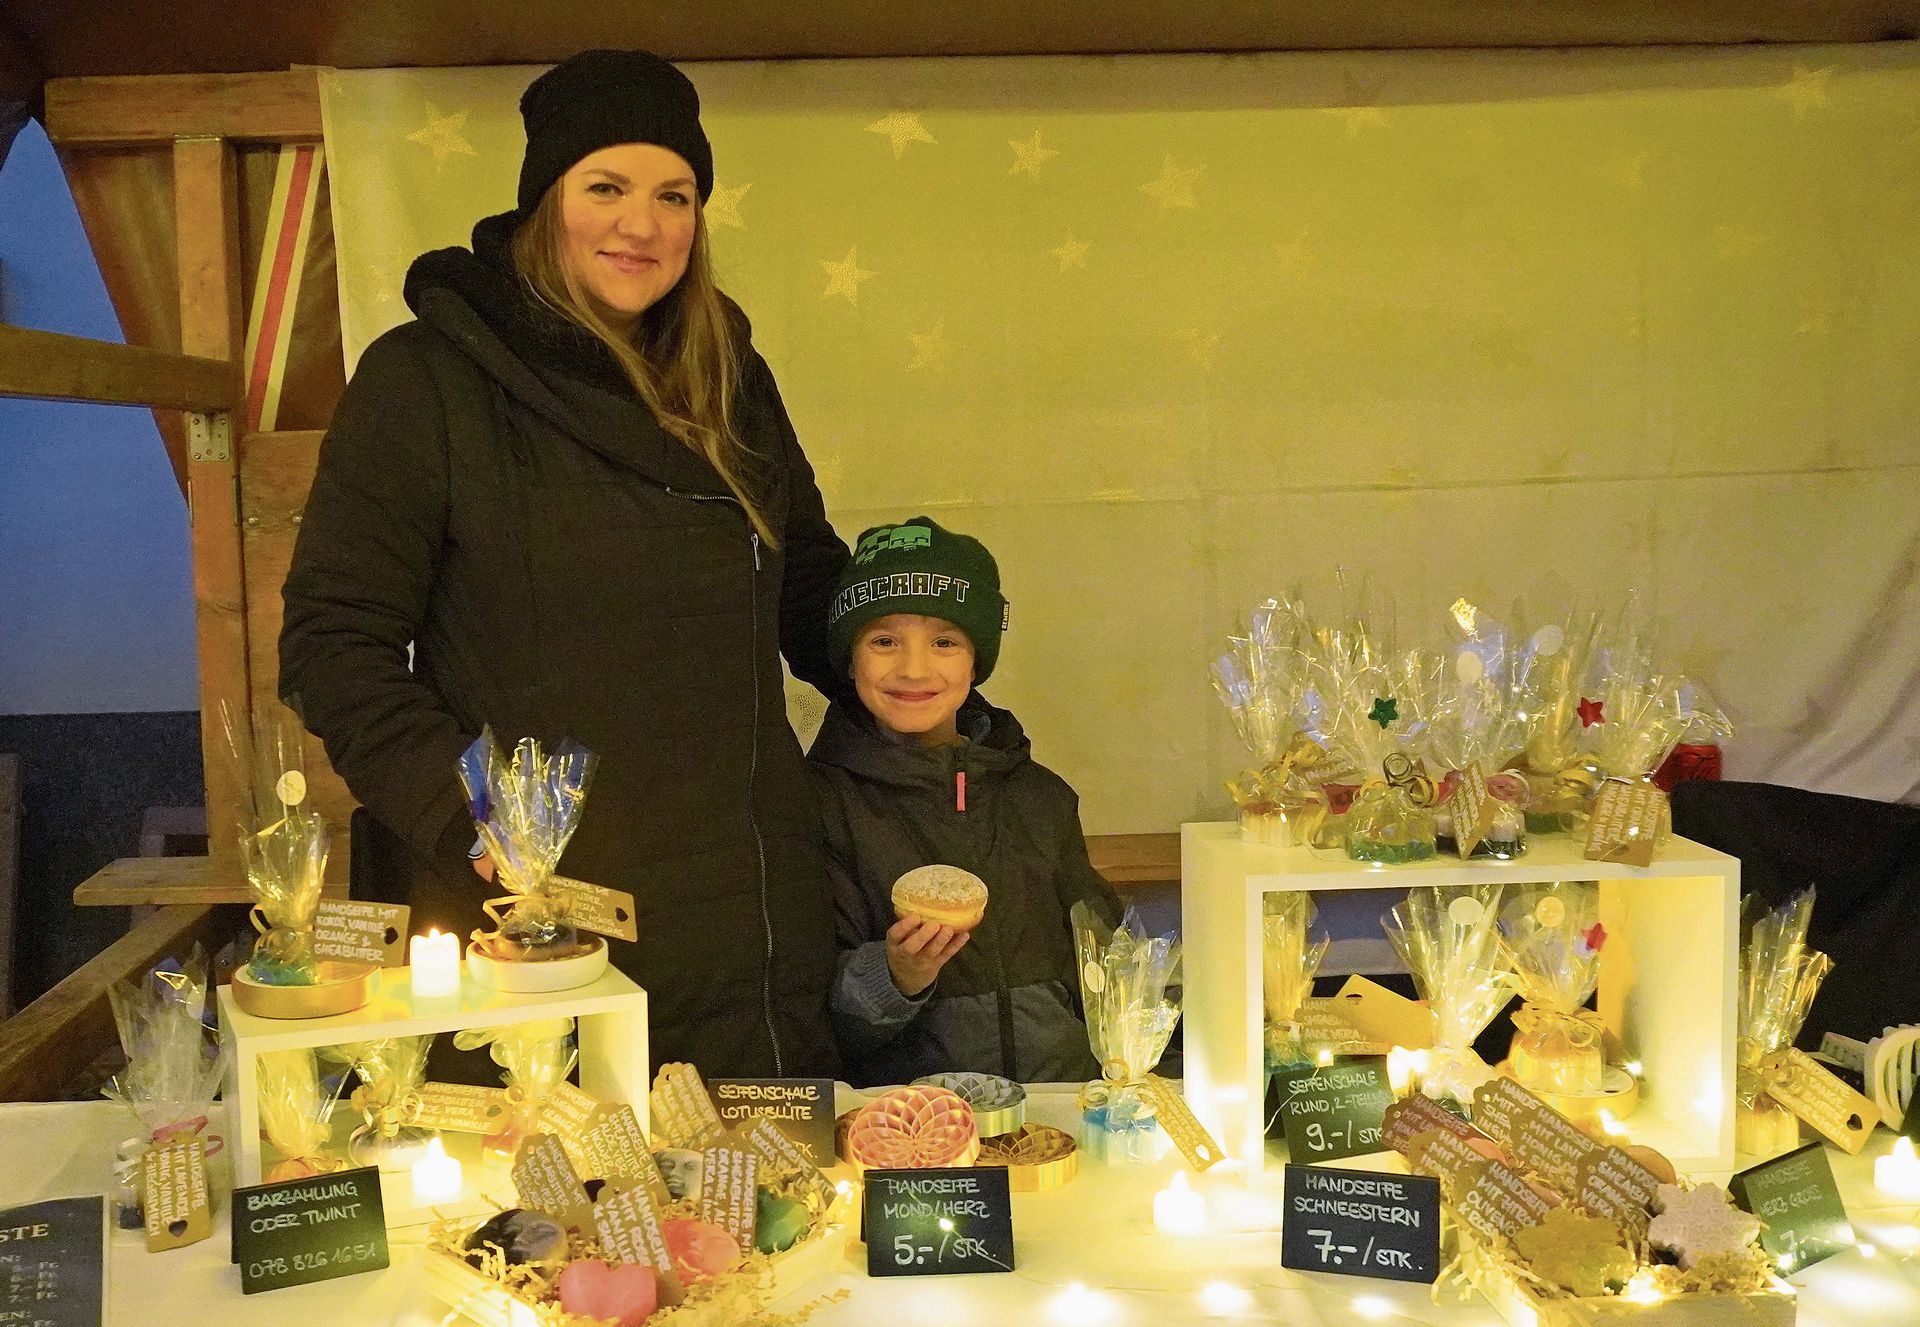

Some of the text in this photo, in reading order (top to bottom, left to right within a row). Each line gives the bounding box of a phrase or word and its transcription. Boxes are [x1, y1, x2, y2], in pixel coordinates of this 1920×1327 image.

[718, 1084, 820, 1101] SEIFENSCHALE
[1288, 1071, 1379, 1094] SEIFENSCHALE
[721, 1102, 812, 1120] LOTUSBLÜTE
[795, 1140, 818, 1159] TK.
[641, 1163, 661, 1187] MIT
[888, 1179, 980, 1195] HANDSEIFE
[1305, 1174, 1408, 1200] HANDSEIFE
[247, 1182, 358, 1211] BARZAHLUNG
[1473, 1174, 1504, 1203] MIT
[250, 1204, 361, 1233] ODER TWINT
[616, 1191, 637, 1224] MIT
[1294, 1196, 1420, 1228] SCHNEESTERN
[1461, 1188, 1521, 1238] OLIVENÖ
[250, 1258, 288, 1278] 078
